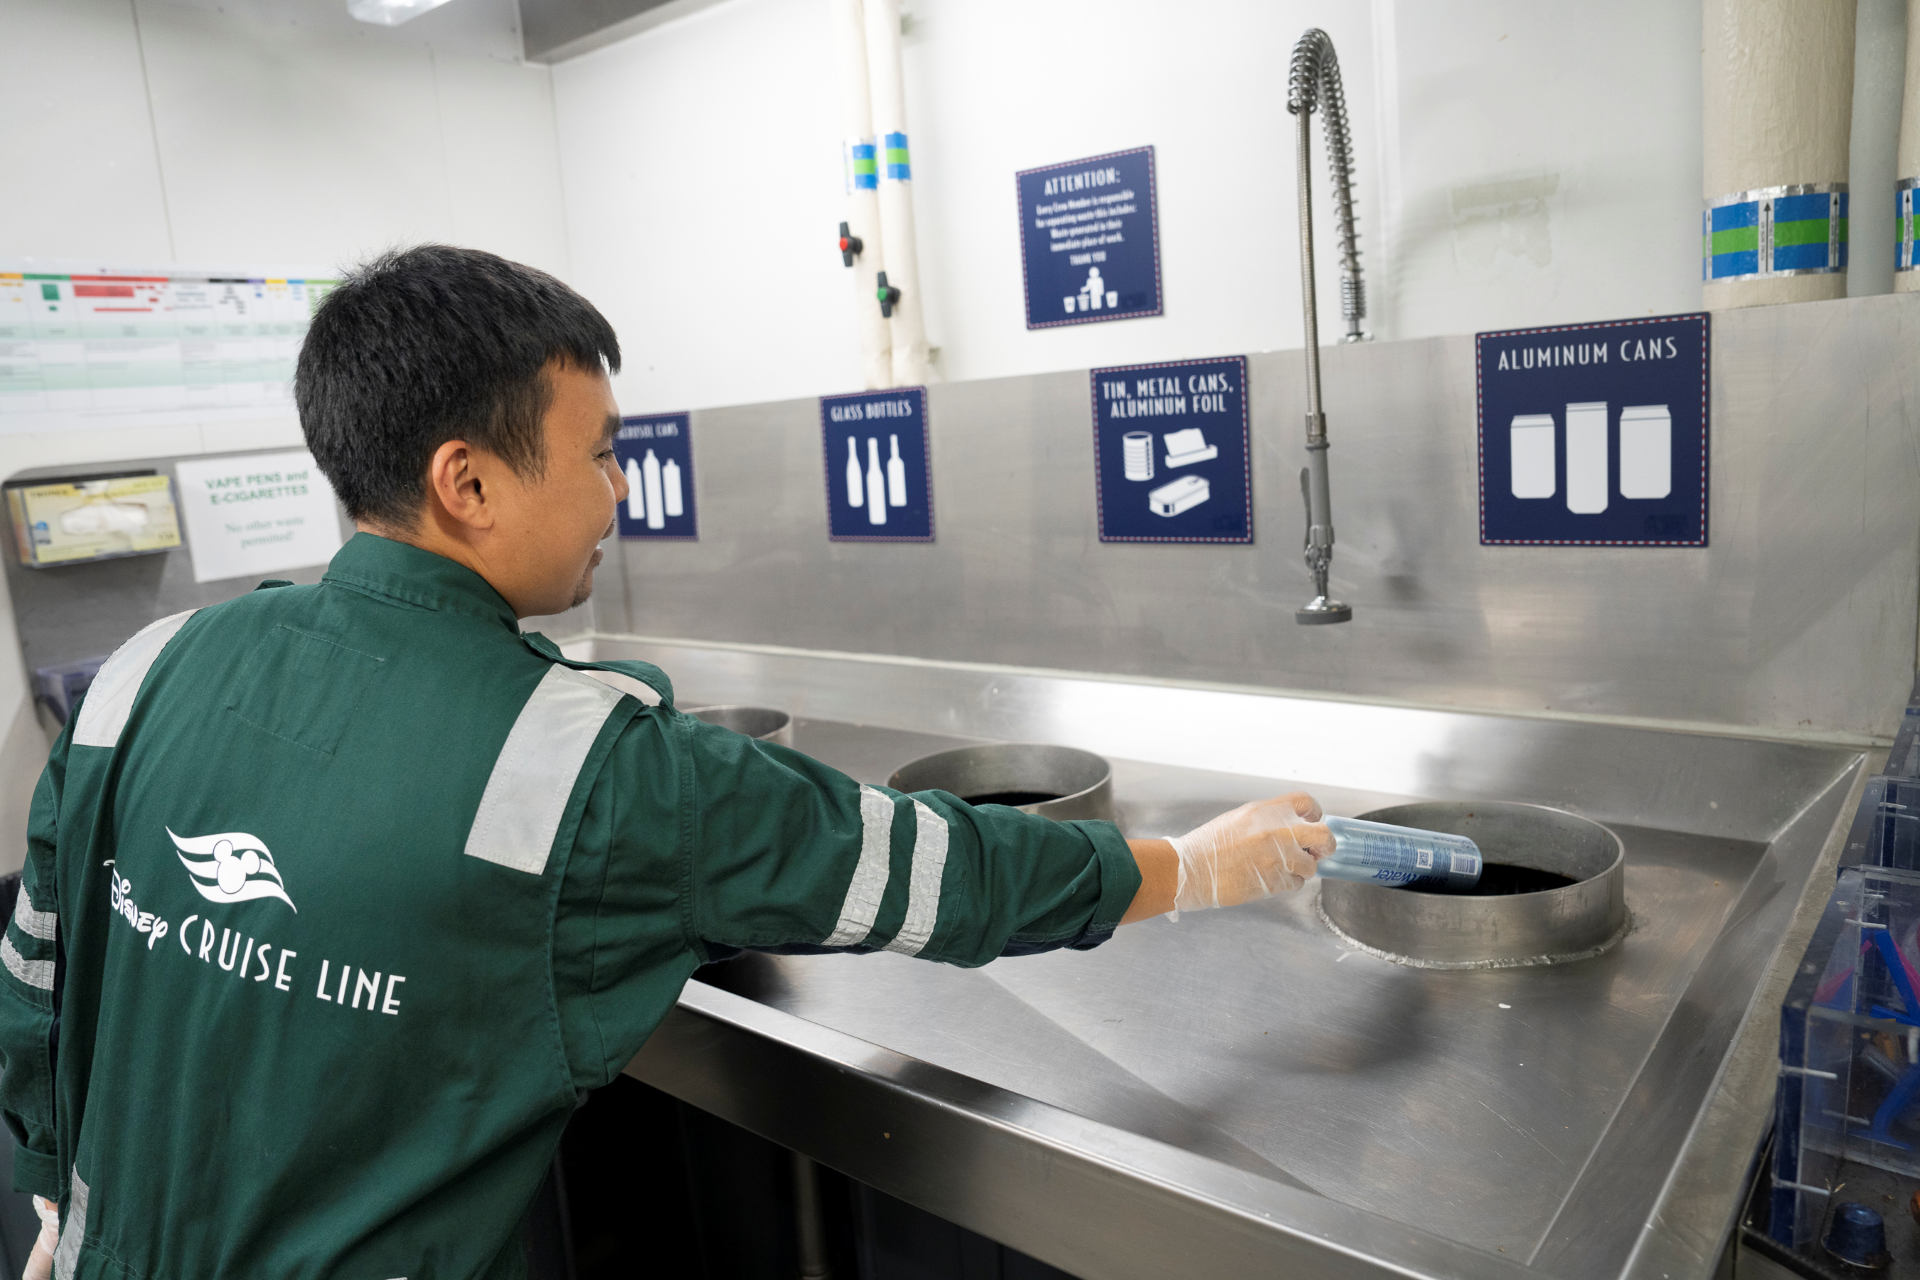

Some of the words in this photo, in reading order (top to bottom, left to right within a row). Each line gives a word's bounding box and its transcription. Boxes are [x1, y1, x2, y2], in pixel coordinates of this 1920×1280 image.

[1044, 167, 1120, 196] ATTENTION:
[1098, 189, 1134, 204] responsible
[1498, 342, 1608, 370] ALUMINUM
[1620, 336, 1677, 362] CANS
[1102, 381, 1132, 400] TIN,
[1136, 376, 1183, 397] METAL
[1188, 373, 1234, 393] CANS,
[830, 404, 862, 422] GLASS
[866, 400, 912, 420] BOTTLES
[1111, 397, 1186, 418] ALUMINUM
[1193, 394, 1226, 413] FOIL
[654, 421, 678, 438] CANS
[205, 476, 242, 489] VAPE
[246, 472, 282, 485] PENS
[287, 470, 308, 482] and
[210, 484, 308, 505] E-CIGARETTES
[225, 522, 243, 534] No
[246, 520, 272, 531] other
[276, 516, 304, 526] waste
[103, 860, 168, 950] Disney
[180, 914, 296, 992] CRUISE
[316, 960, 406, 1015] LINE
